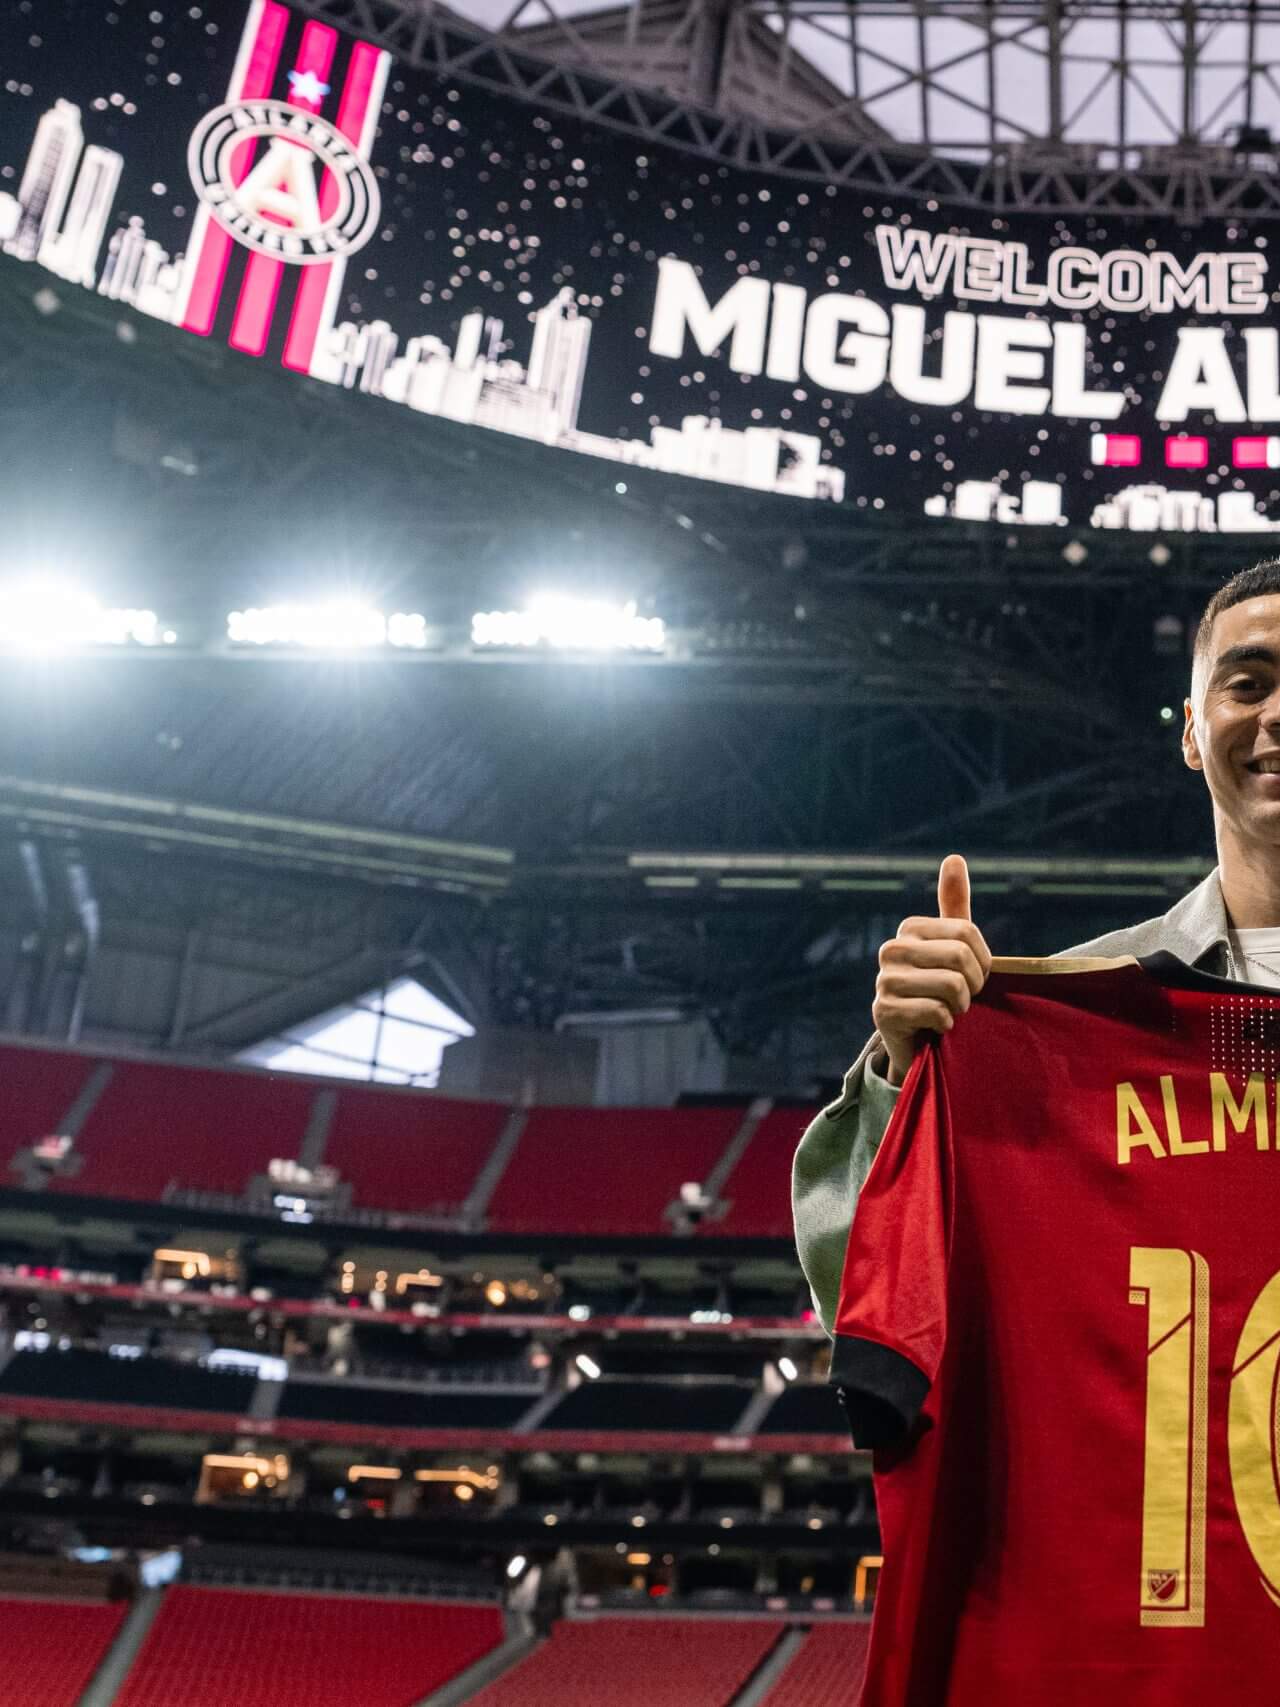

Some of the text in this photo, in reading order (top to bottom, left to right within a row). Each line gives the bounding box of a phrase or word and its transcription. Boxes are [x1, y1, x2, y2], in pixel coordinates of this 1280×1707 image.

[234, 136, 322, 232] A
[875, 224, 1269, 315] WELCOME
[648, 256, 1127, 420] MIGUEL
